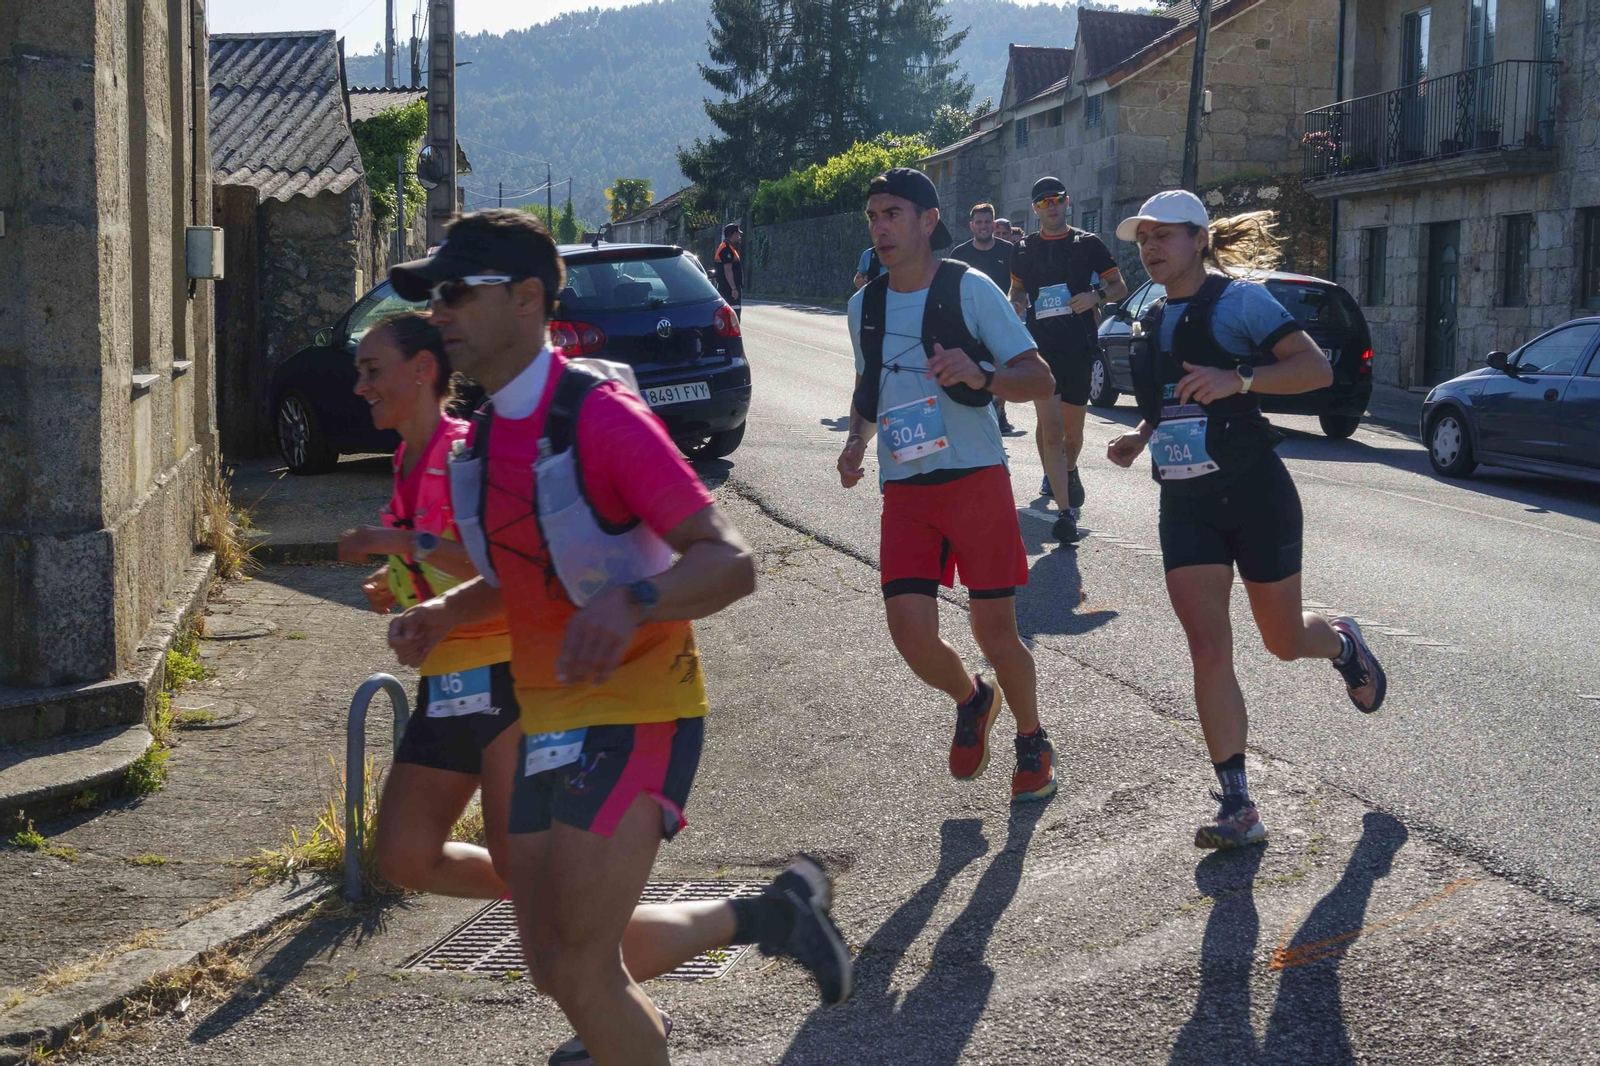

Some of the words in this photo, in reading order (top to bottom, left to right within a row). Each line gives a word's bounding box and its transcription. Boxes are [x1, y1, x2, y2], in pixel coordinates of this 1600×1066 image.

[1042, 297, 1062, 308] 428
[649, 387, 680, 404] 8491
[683, 384, 706, 399] FVY
[891, 423, 926, 447] 304
[1164, 444, 1192, 462] 264
